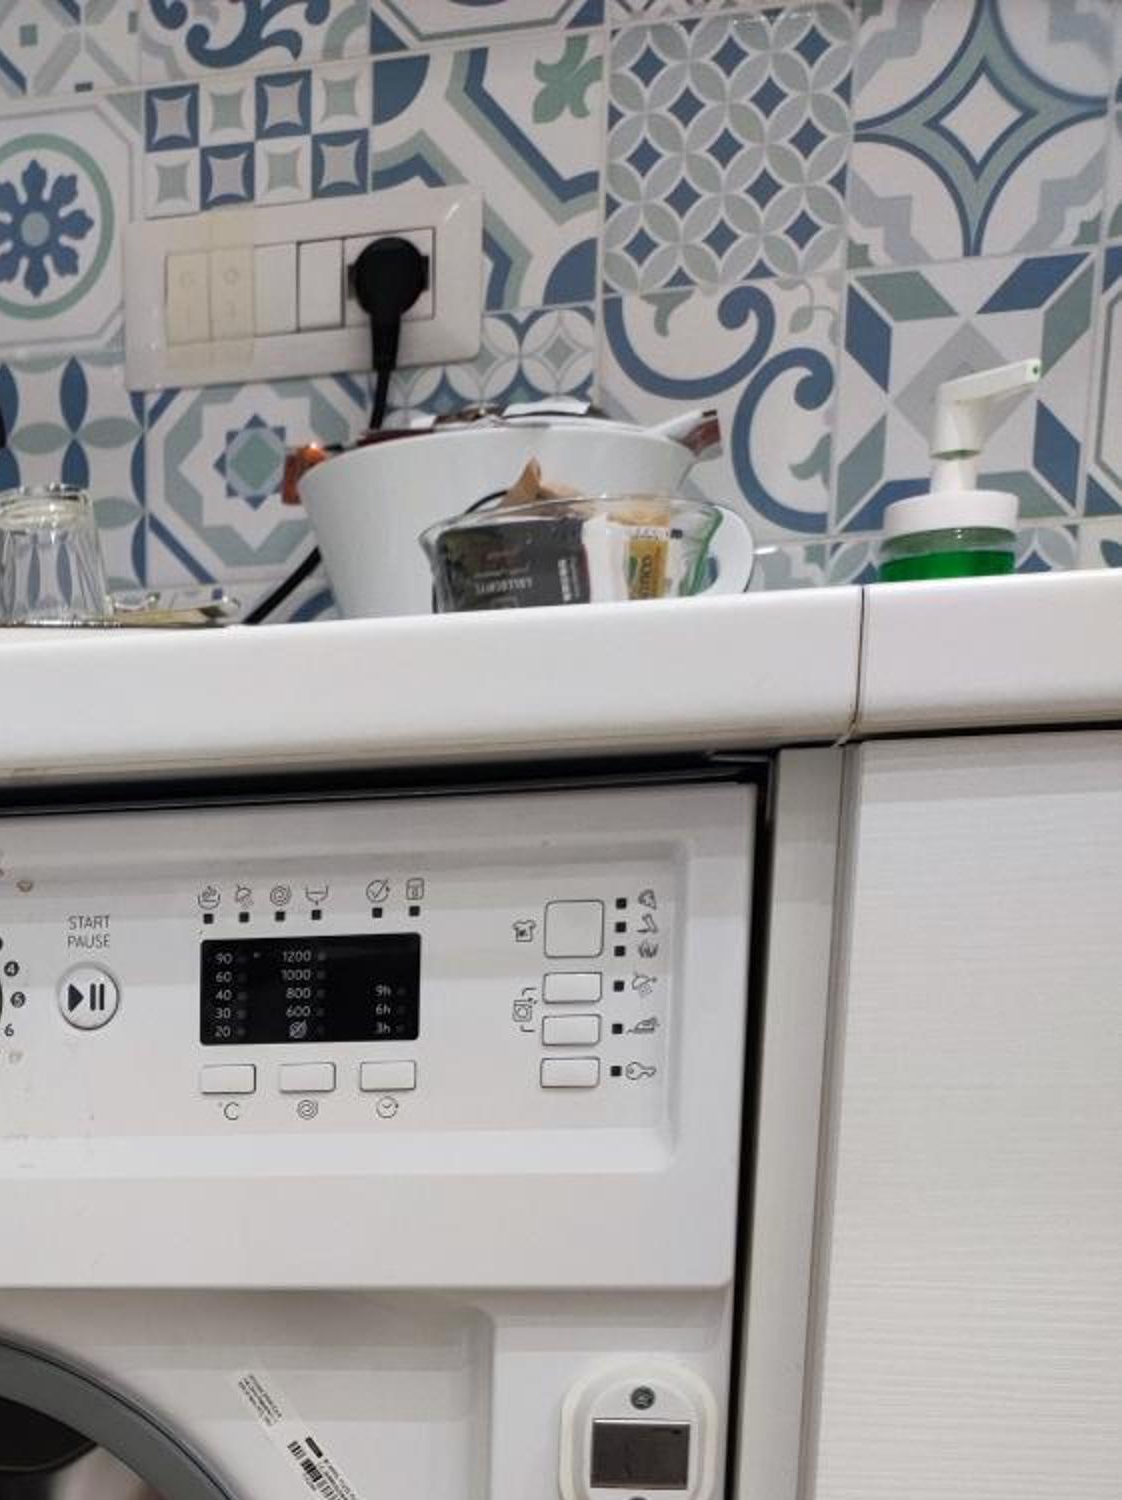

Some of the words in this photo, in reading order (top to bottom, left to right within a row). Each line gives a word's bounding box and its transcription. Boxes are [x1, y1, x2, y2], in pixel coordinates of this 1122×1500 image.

[68, 915, 111, 929] START
[67, 935, 111, 949] PAUSE
[215, 953, 233, 964] 90
[282, 951, 312, 962] 1200
[215, 972, 233, 983] 60
[282, 970, 312, 981] 1000
[215, 990, 232, 1001] 40
[285, 988, 311, 999] 800
[215, 1008, 231, 1019] 30
[285, 1006, 311, 1017] 600
[375, 1004, 391, 1015] 6h
[4, 1025, 15, 1037] 6
[215, 1026, 231, 1038] 20
